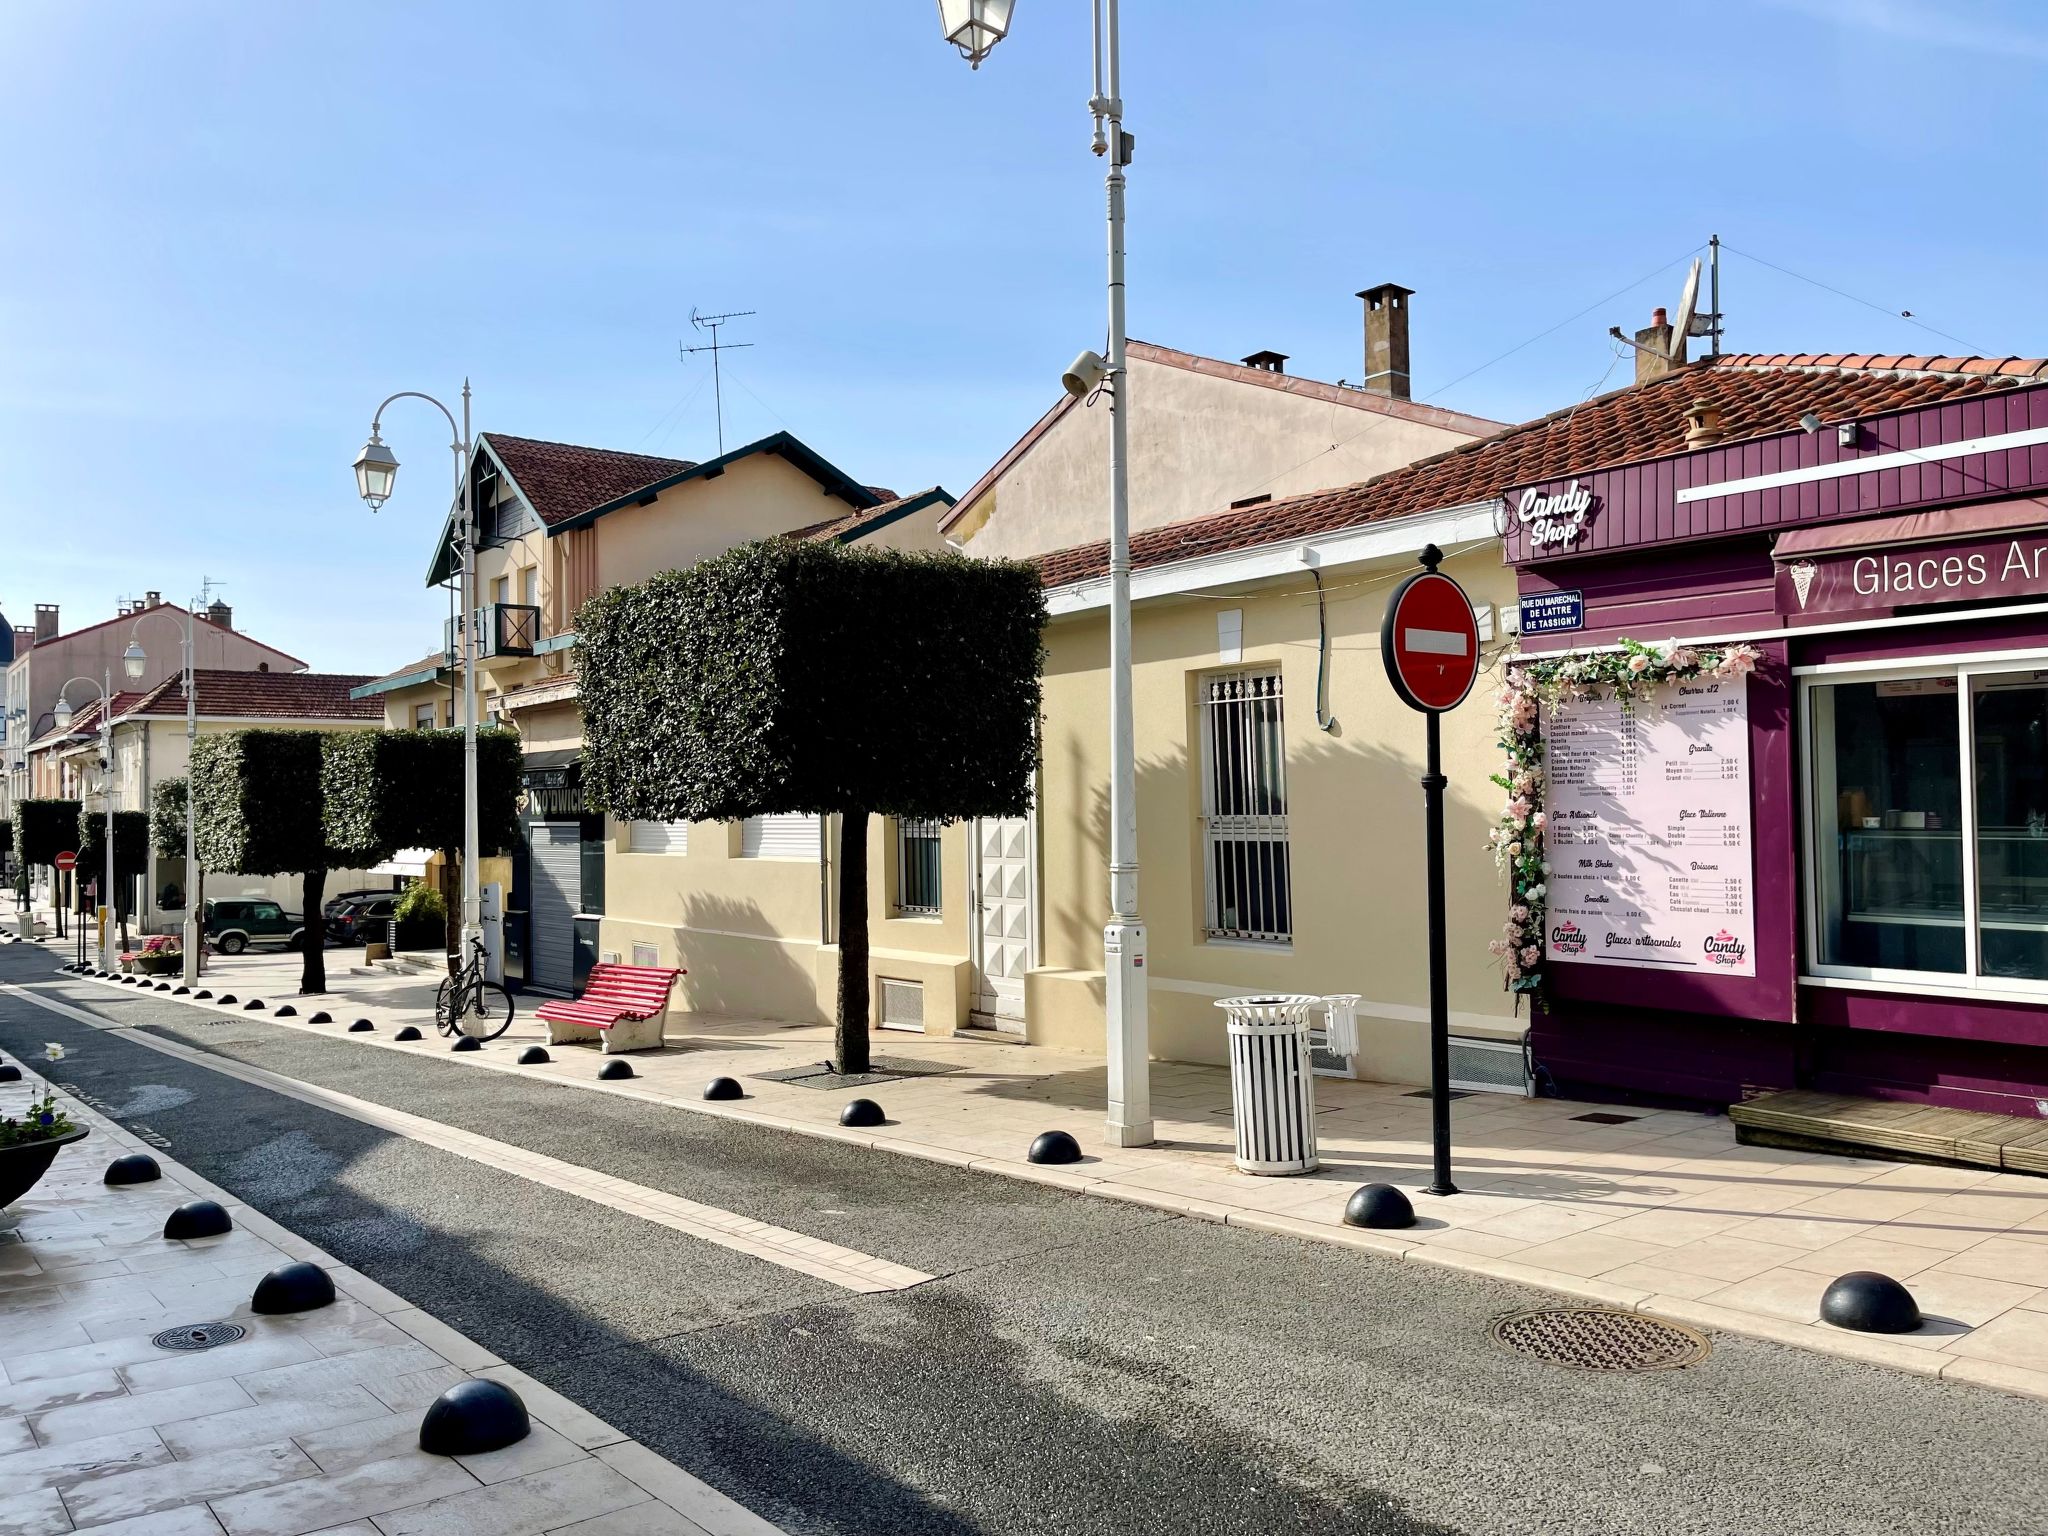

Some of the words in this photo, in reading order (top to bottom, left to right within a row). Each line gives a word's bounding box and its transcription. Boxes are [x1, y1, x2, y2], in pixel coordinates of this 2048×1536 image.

[1518, 480, 1591, 523] Candy
[1530, 519, 1577, 548] Shop
[1853, 553, 1987, 595] Glaces
[2001, 541, 2048, 582] Ar
[1521, 600, 1534, 608] RUE
[1535, 598, 1544, 607] DU
[1545, 594, 1580, 605] MARECHAL
[1530, 609, 1540, 618] DE
[1542, 605, 1572, 617] LATTRE
[1526, 621, 1536, 630] DE
[1539, 616, 1577, 628] TASSIGNY
[1680, 810, 1696, 821] Glace
[1690, 862, 1718, 870] Boissons
[1552, 926, 1587, 948] Candy
[1606, 932, 1631, 947] Glaces
[1636, 935, 1681, 948] artisanales
[1561, 943, 1579, 956] Shop
[1704, 936, 1746, 960] Candy
[1715, 954, 1736, 967] Shop
